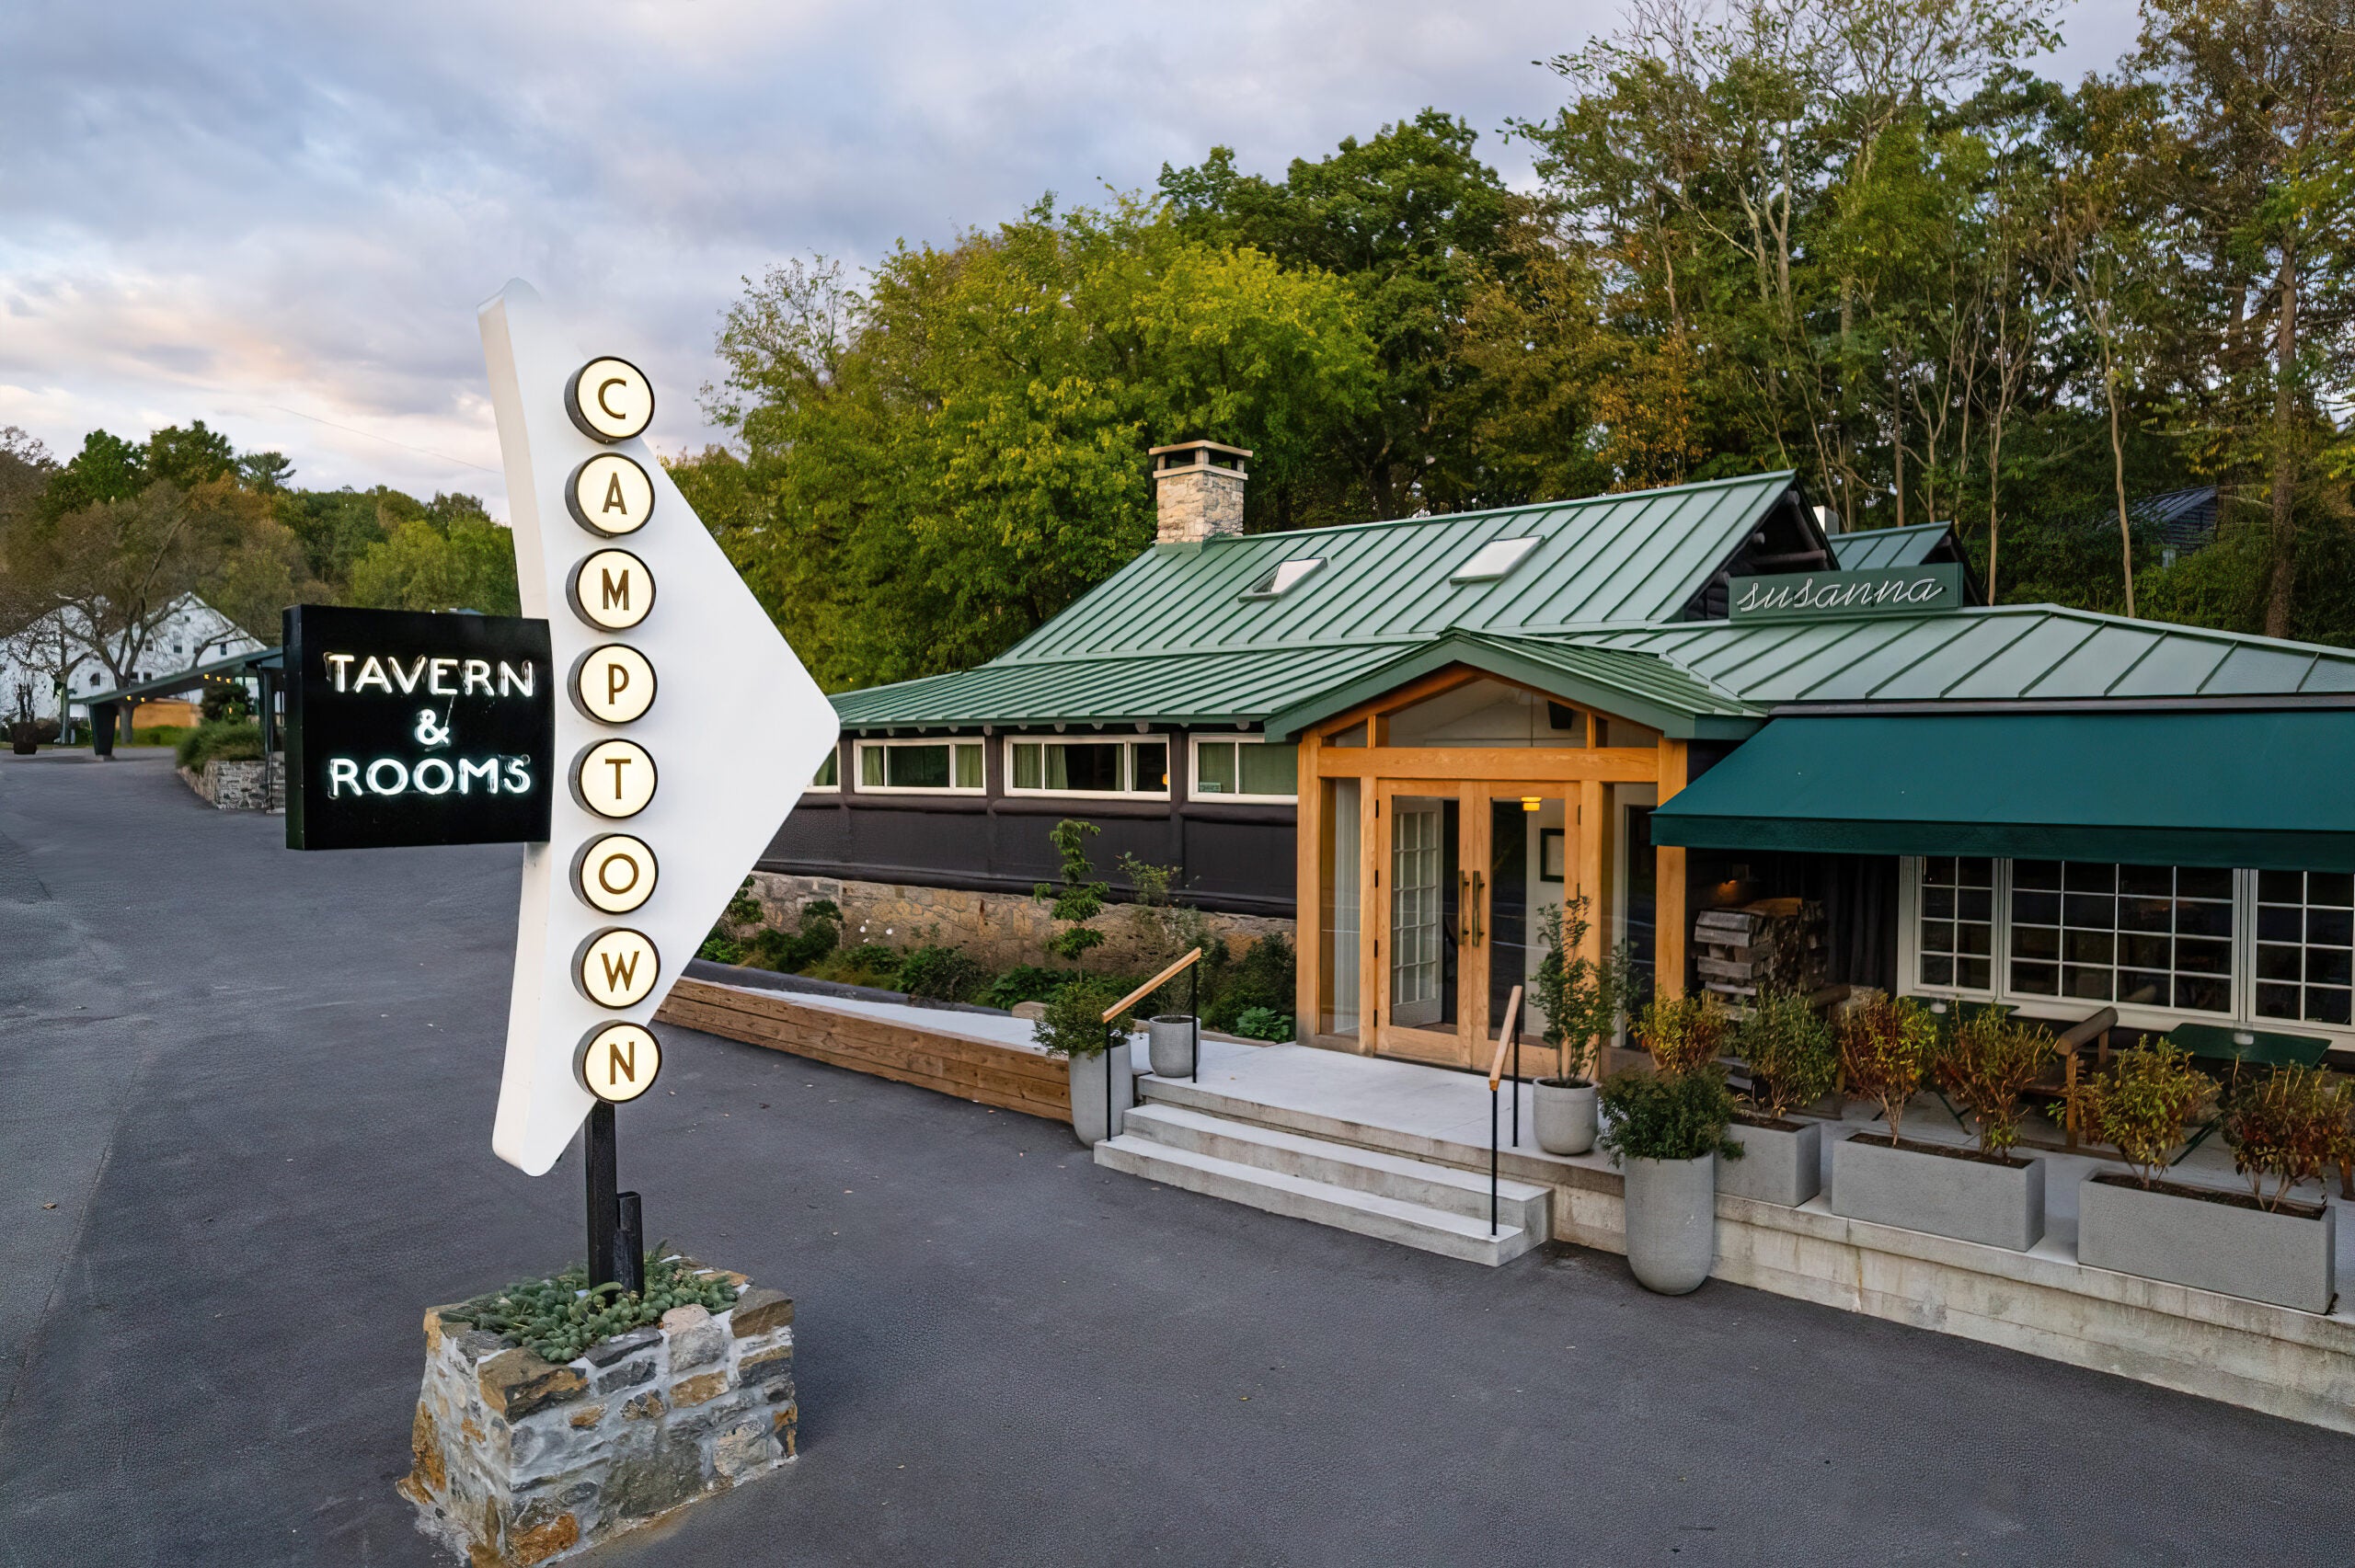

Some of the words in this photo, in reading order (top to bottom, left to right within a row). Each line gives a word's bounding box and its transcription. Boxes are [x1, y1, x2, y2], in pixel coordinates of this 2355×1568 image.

[1737, 578, 1943, 612] susanna
[327, 653, 534, 697] TAVERN
[416, 708, 450, 746] &
[597, 377, 641, 1086] CAMPTOWN
[329, 757, 532, 796] ROOMS
